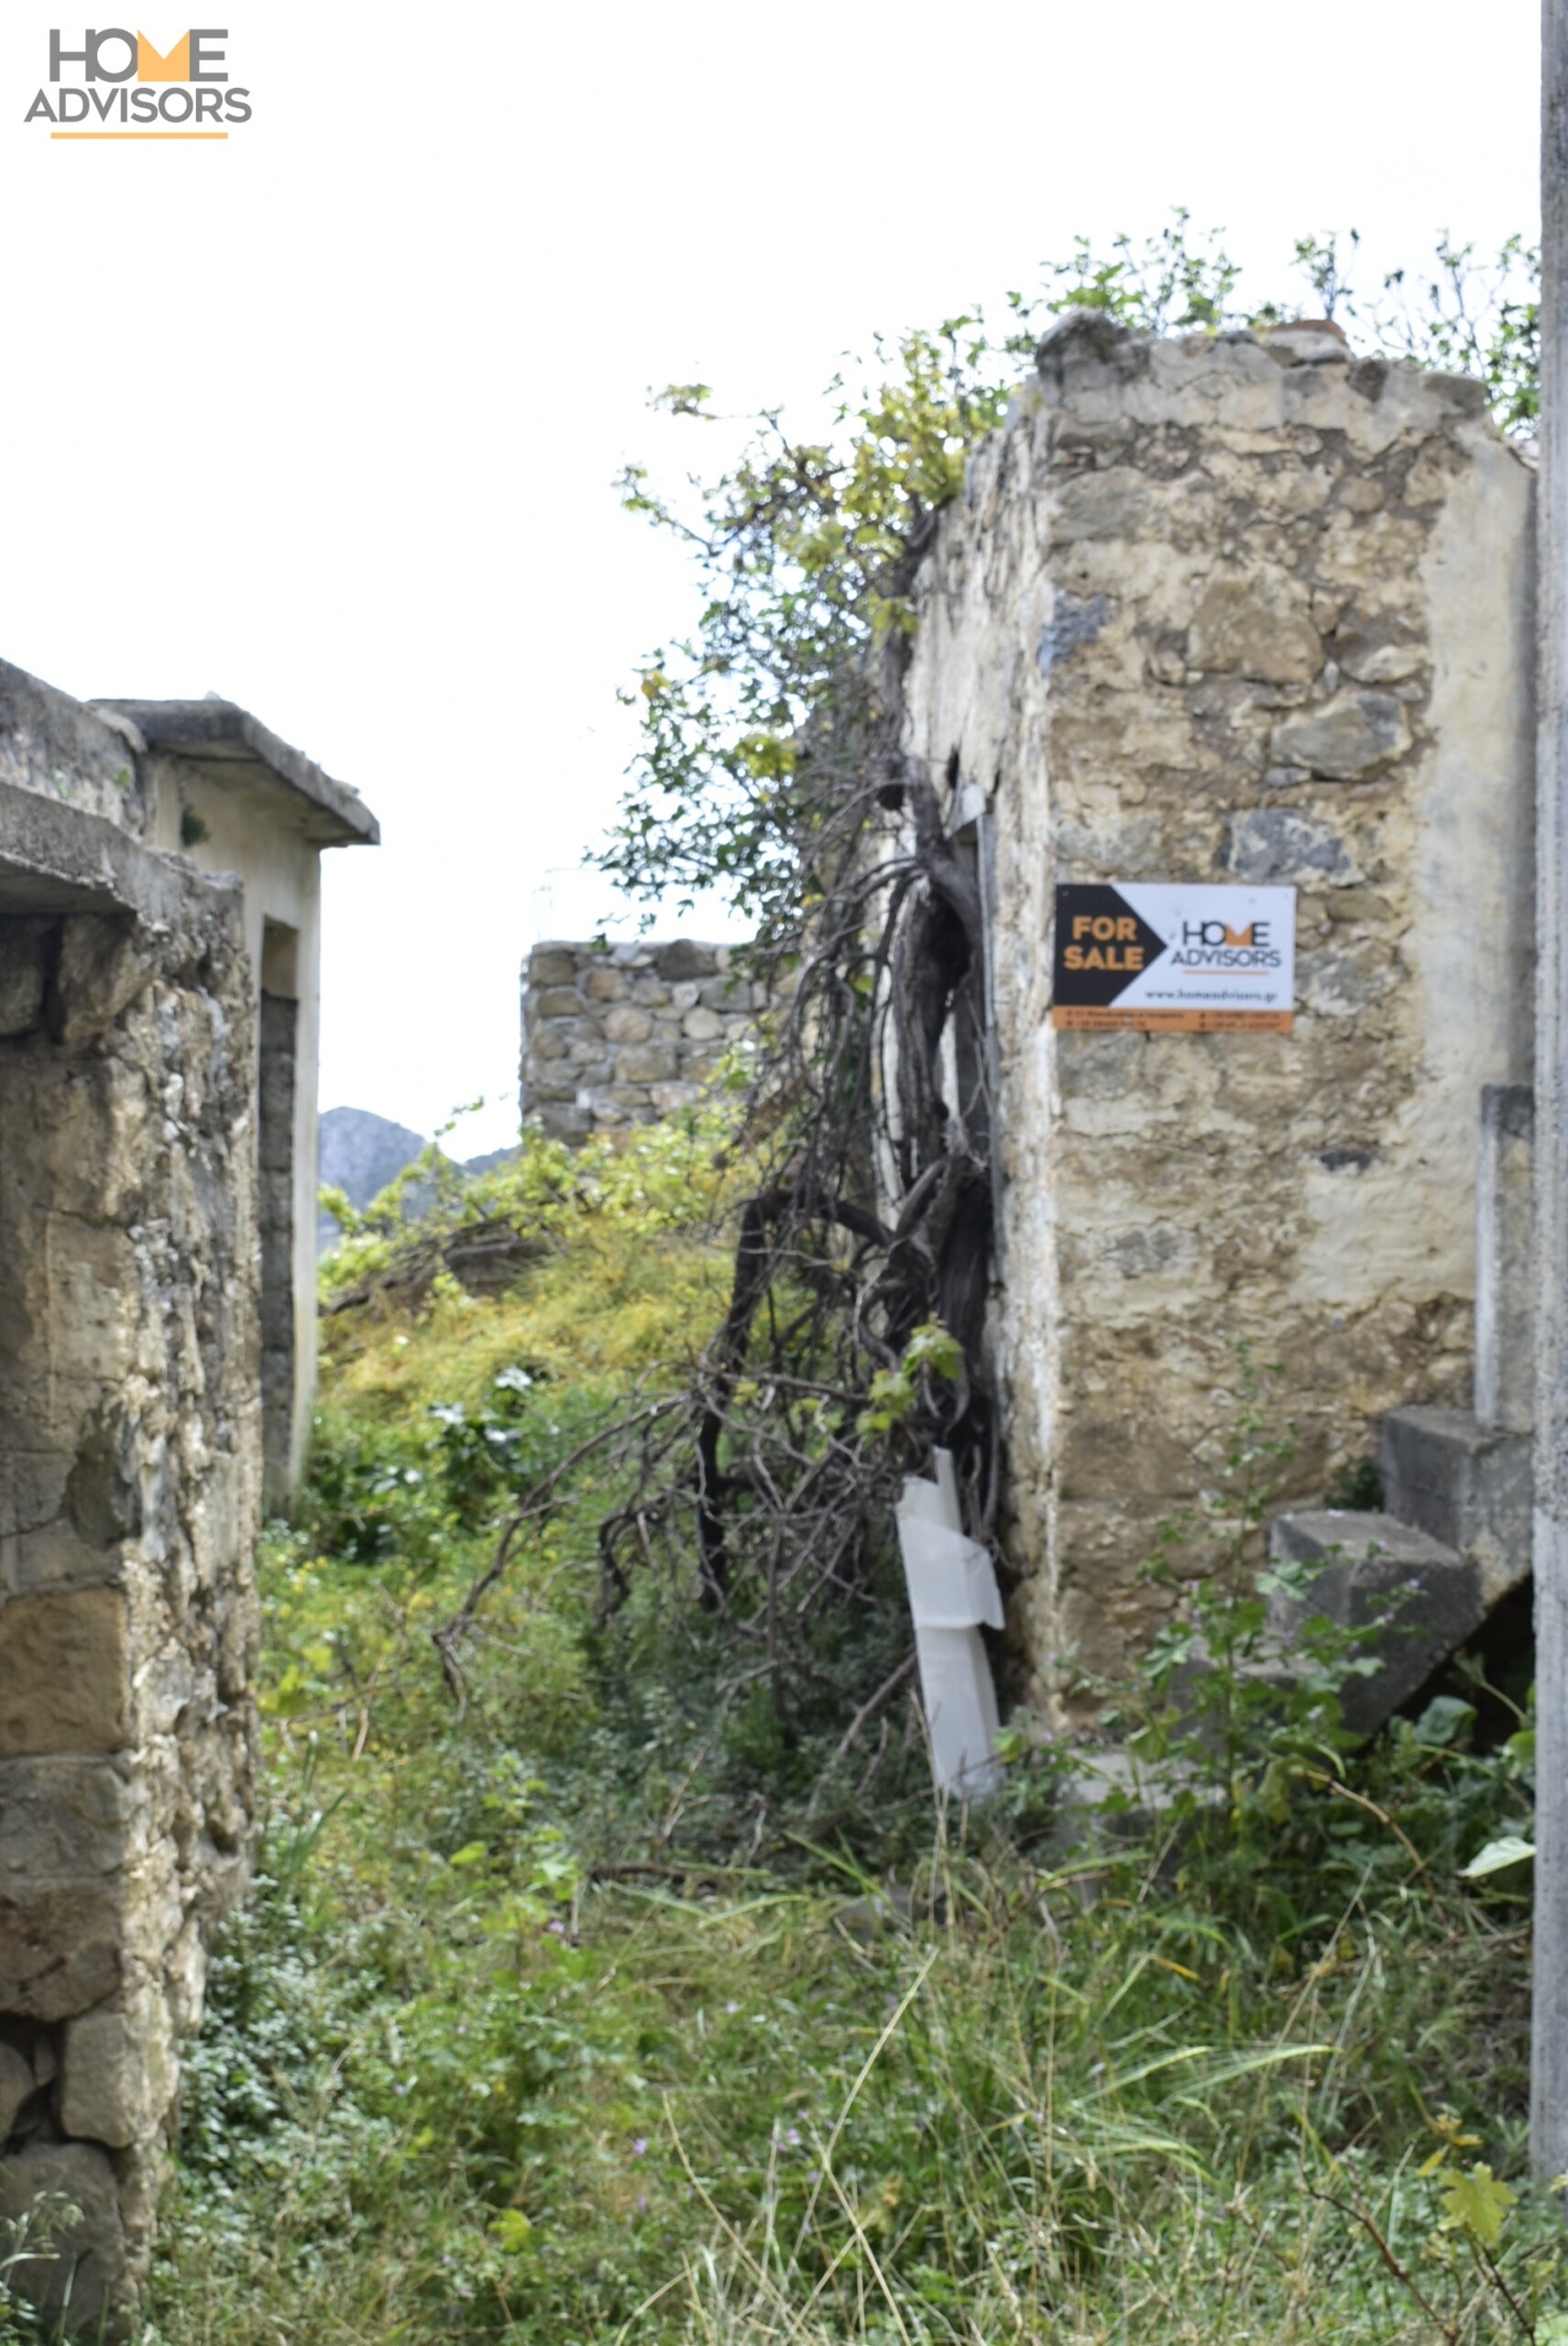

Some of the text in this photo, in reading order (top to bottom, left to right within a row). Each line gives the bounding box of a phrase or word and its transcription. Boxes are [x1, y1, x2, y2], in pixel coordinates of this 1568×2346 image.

[1072, 915, 1137, 941] FOR
[1183, 920, 1270, 947] HOME
[1064, 946, 1145, 970] SALE
[1170, 948, 1282, 968] ADVISORS
[1146, 988, 1277, 1003] www.homeadvisors.gr
